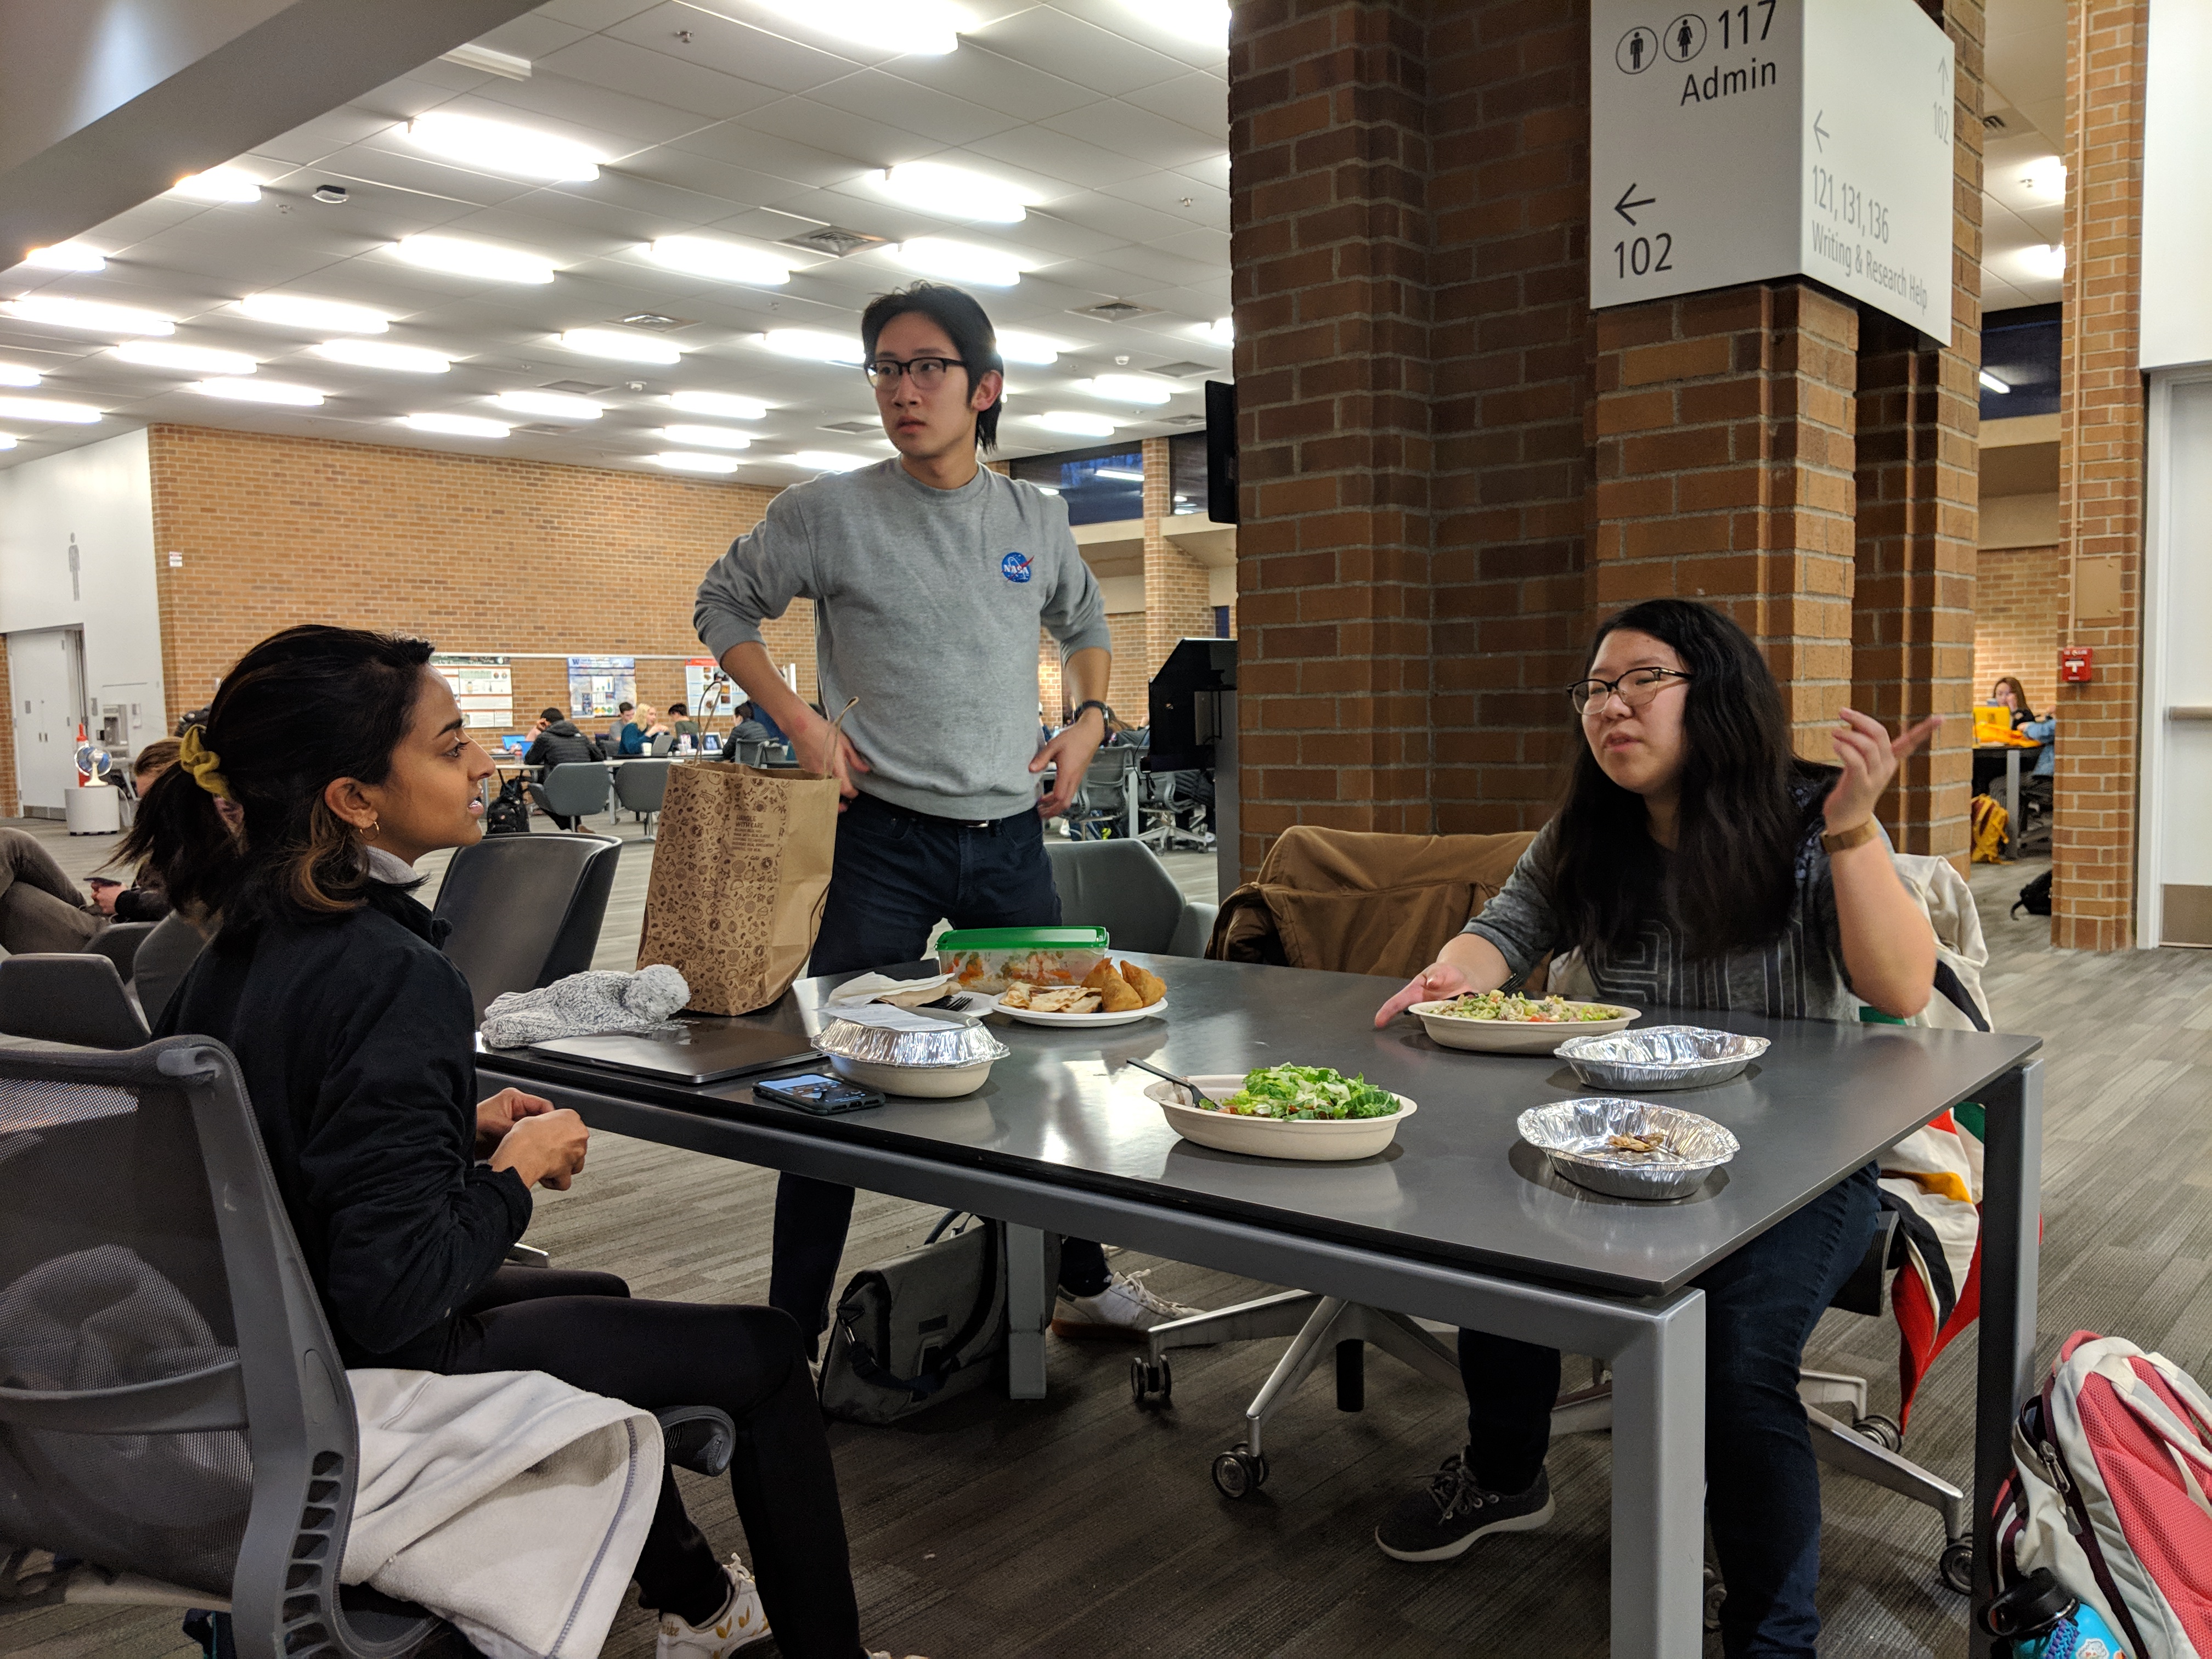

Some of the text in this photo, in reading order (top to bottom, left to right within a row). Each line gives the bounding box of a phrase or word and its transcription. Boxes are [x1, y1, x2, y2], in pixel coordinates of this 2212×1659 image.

[1718, 0, 1776, 49] 117
[1680, 57, 1776, 106] Admin
[1933, 101, 1949, 145] 102
[1868, 199, 1889, 244] 136
[1614, 233, 1672, 279] 102
[1812, 220, 1928, 316] Writing & Research Help
[1003, 564, 1030, 574] NASA
